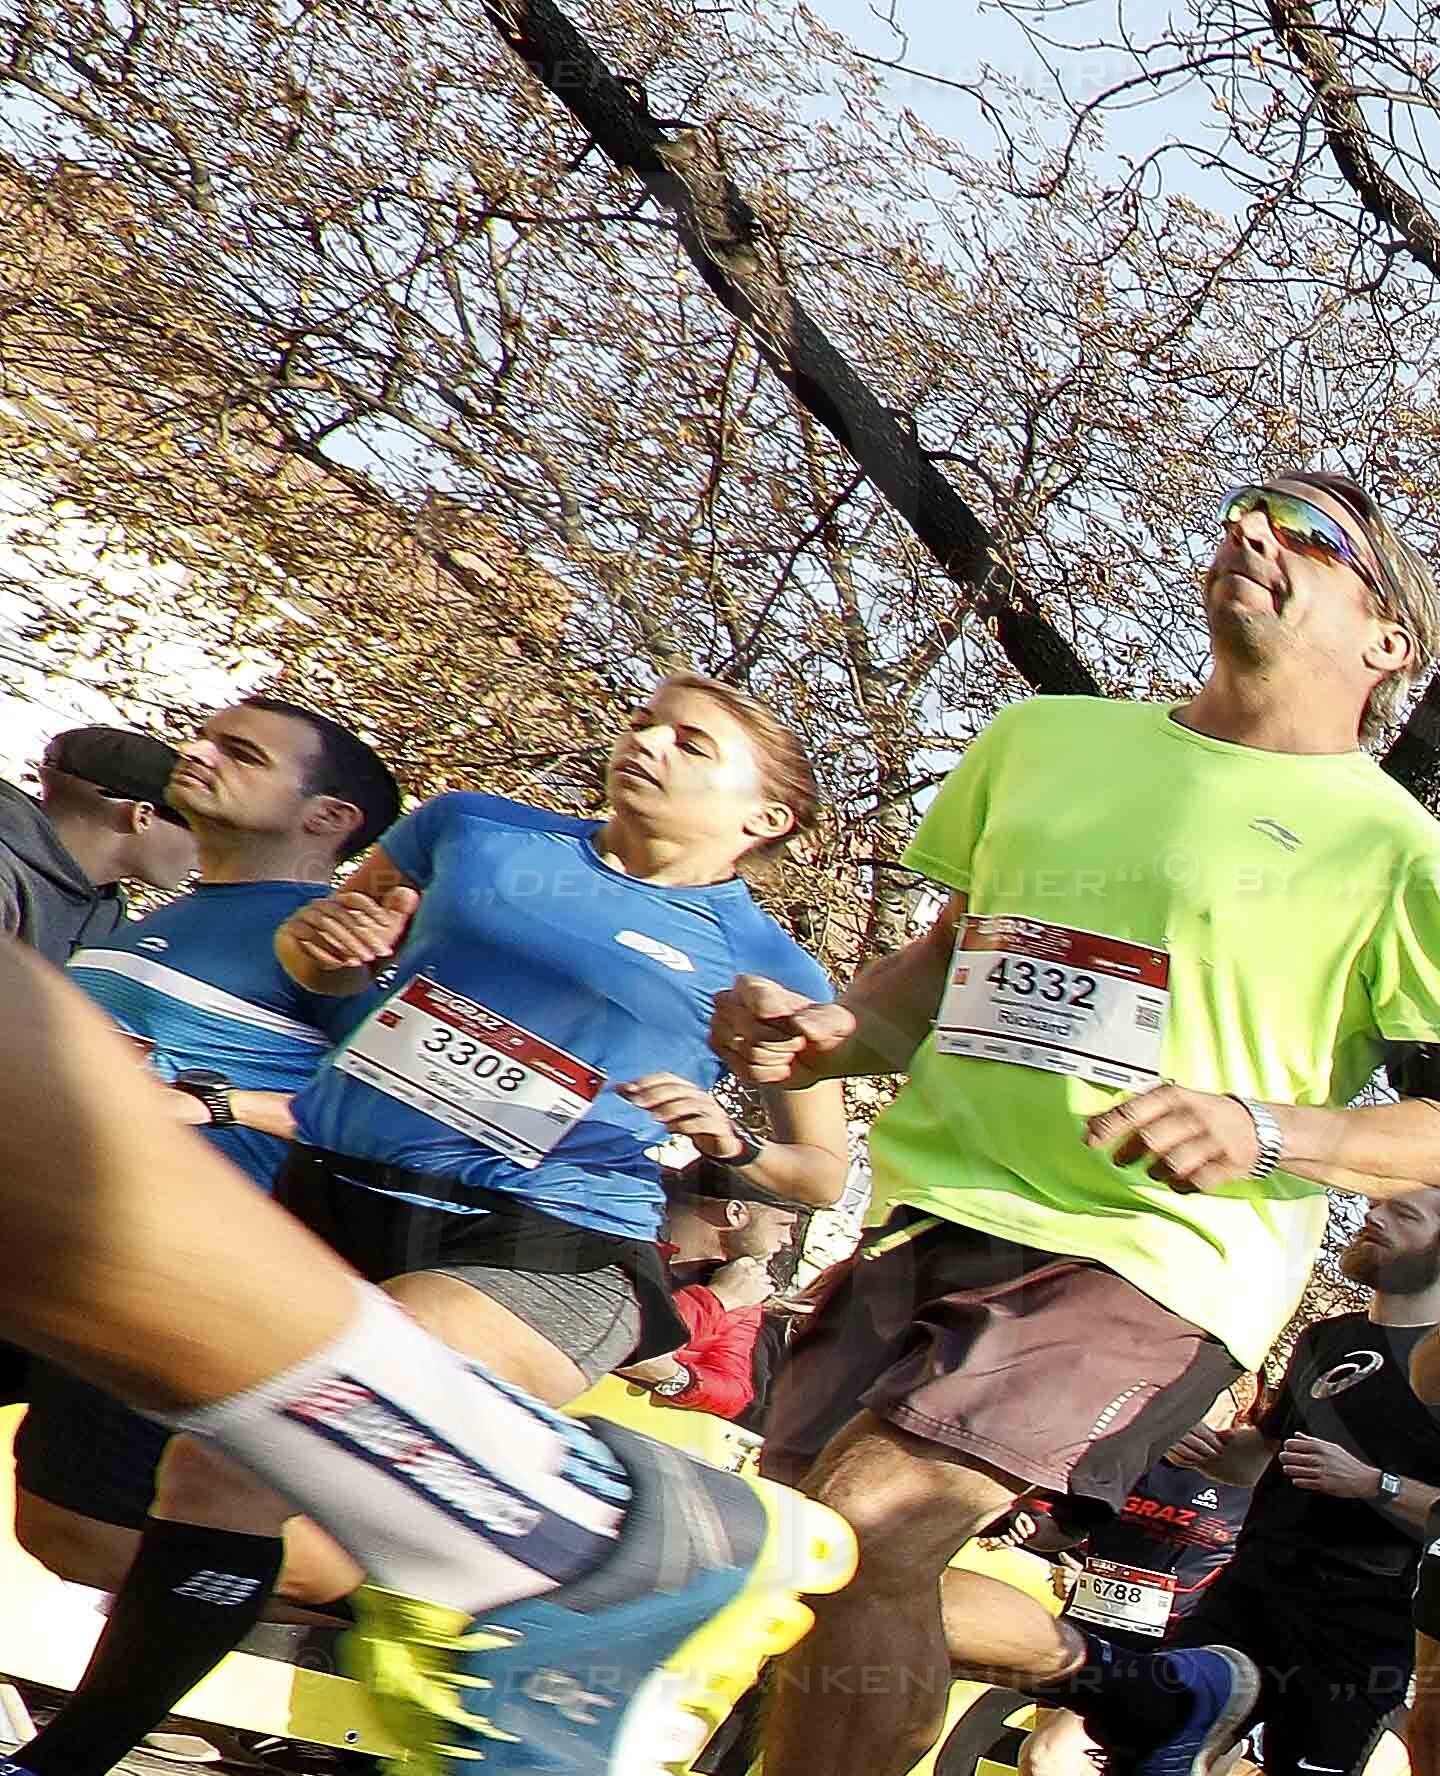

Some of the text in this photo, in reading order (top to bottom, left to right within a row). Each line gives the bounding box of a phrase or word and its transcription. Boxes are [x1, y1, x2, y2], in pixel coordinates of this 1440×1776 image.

[985, 958, 1097, 1011] 4332
[997, 1009, 1072, 1038] Richard
[421, 1026, 527, 1093] 3308
[1092, 1578, 1143, 1604] 6788
